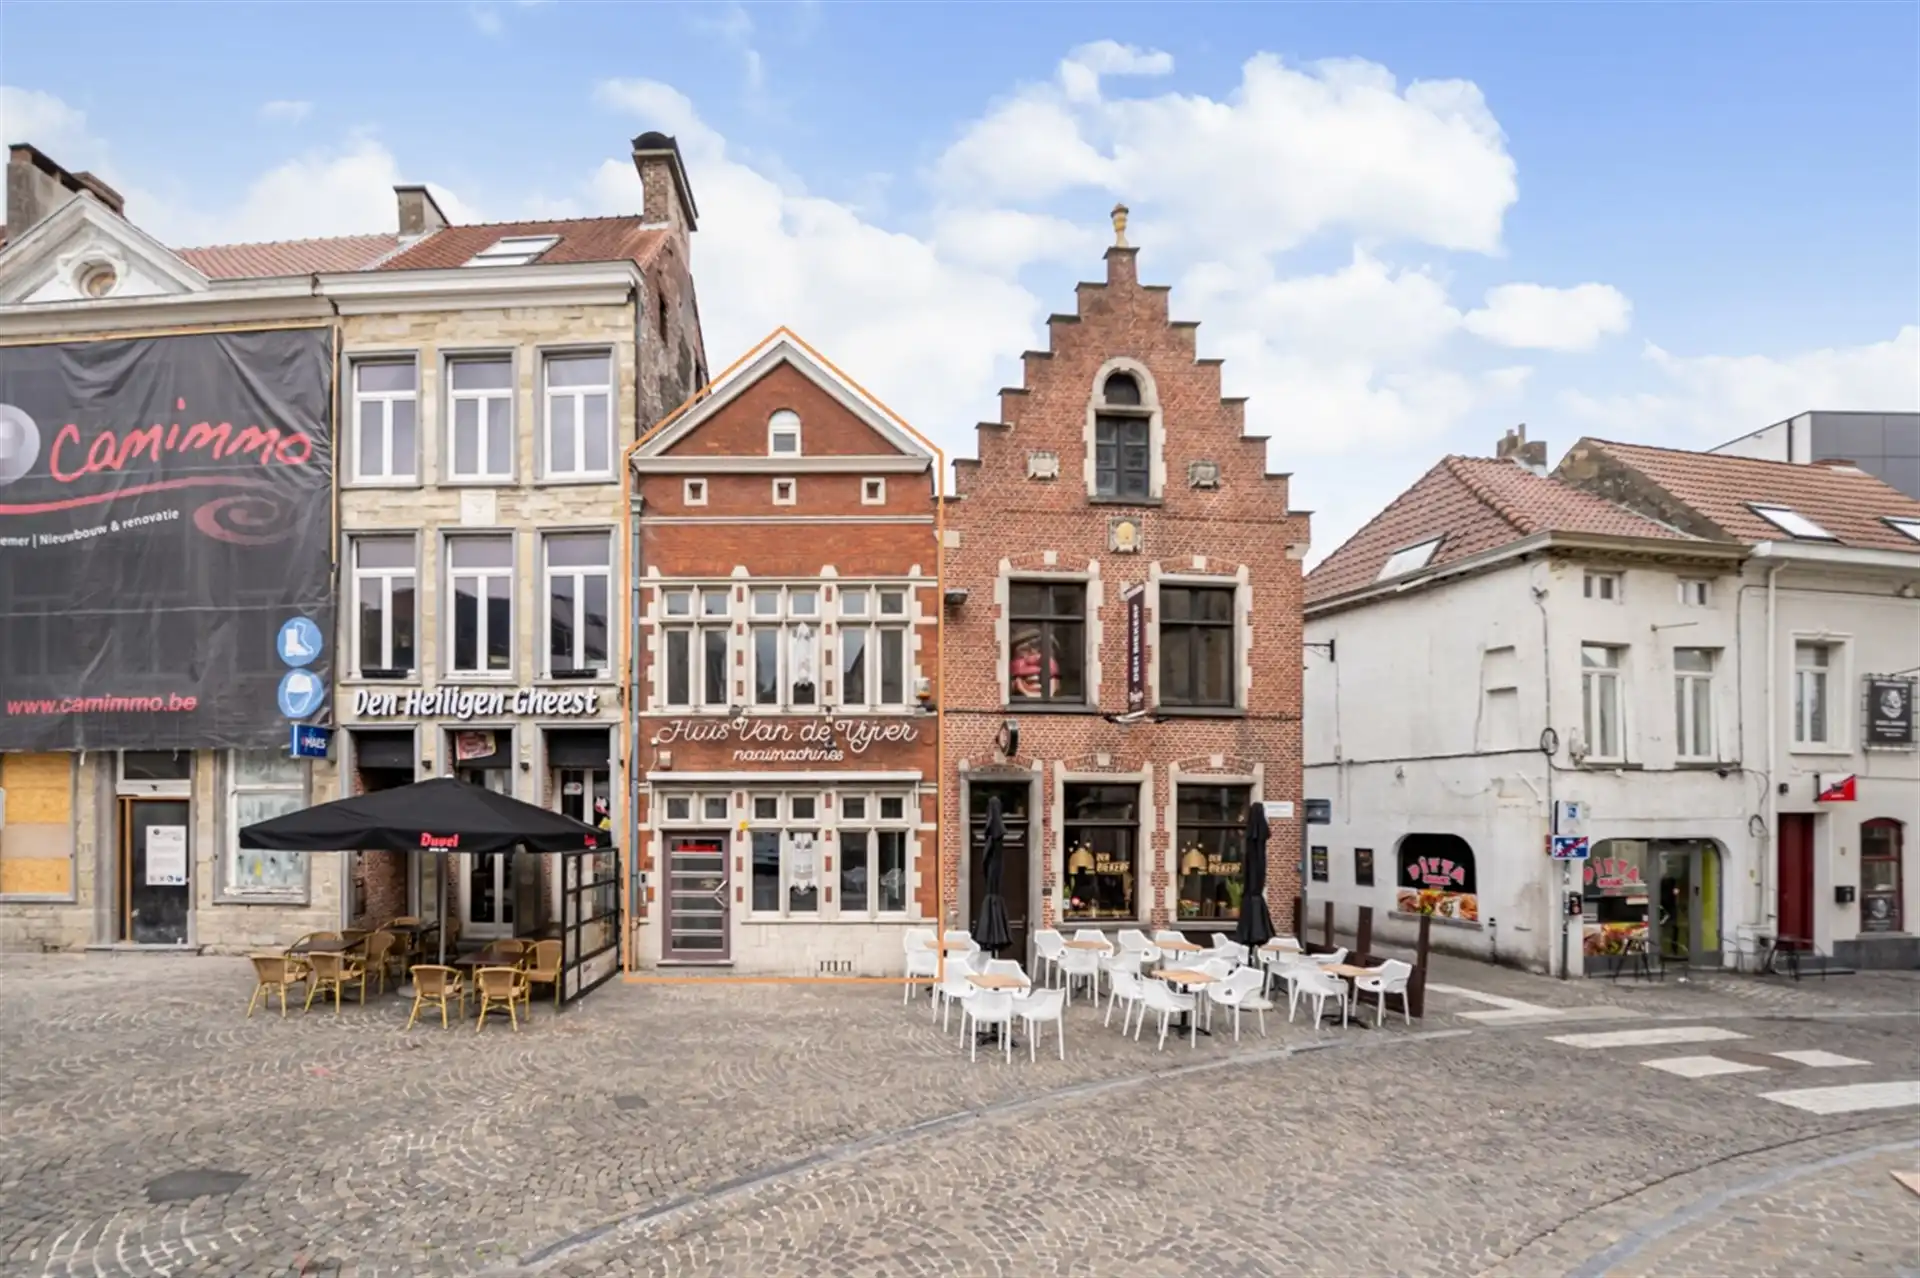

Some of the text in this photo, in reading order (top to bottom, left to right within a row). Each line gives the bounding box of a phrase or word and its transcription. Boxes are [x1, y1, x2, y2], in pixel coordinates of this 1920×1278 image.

[51, 397, 312, 482] Camimmo
[39, 525, 108, 545] Nieuwbouw
[110, 520, 120, 532] &
[122, 508, 180, 529] renovatie
[7, 692, 197, 715] www.camimmo.be
[354, 687, 598, 719] Den Heiligen Gheest
[656, 719, 732, 743] Huis
[732, 719, 793, 742] Van
[799, 720, 831, 742] de
[733, 748, 844, 762] naaimachines
[420, 832, 459, 848] Duvel
